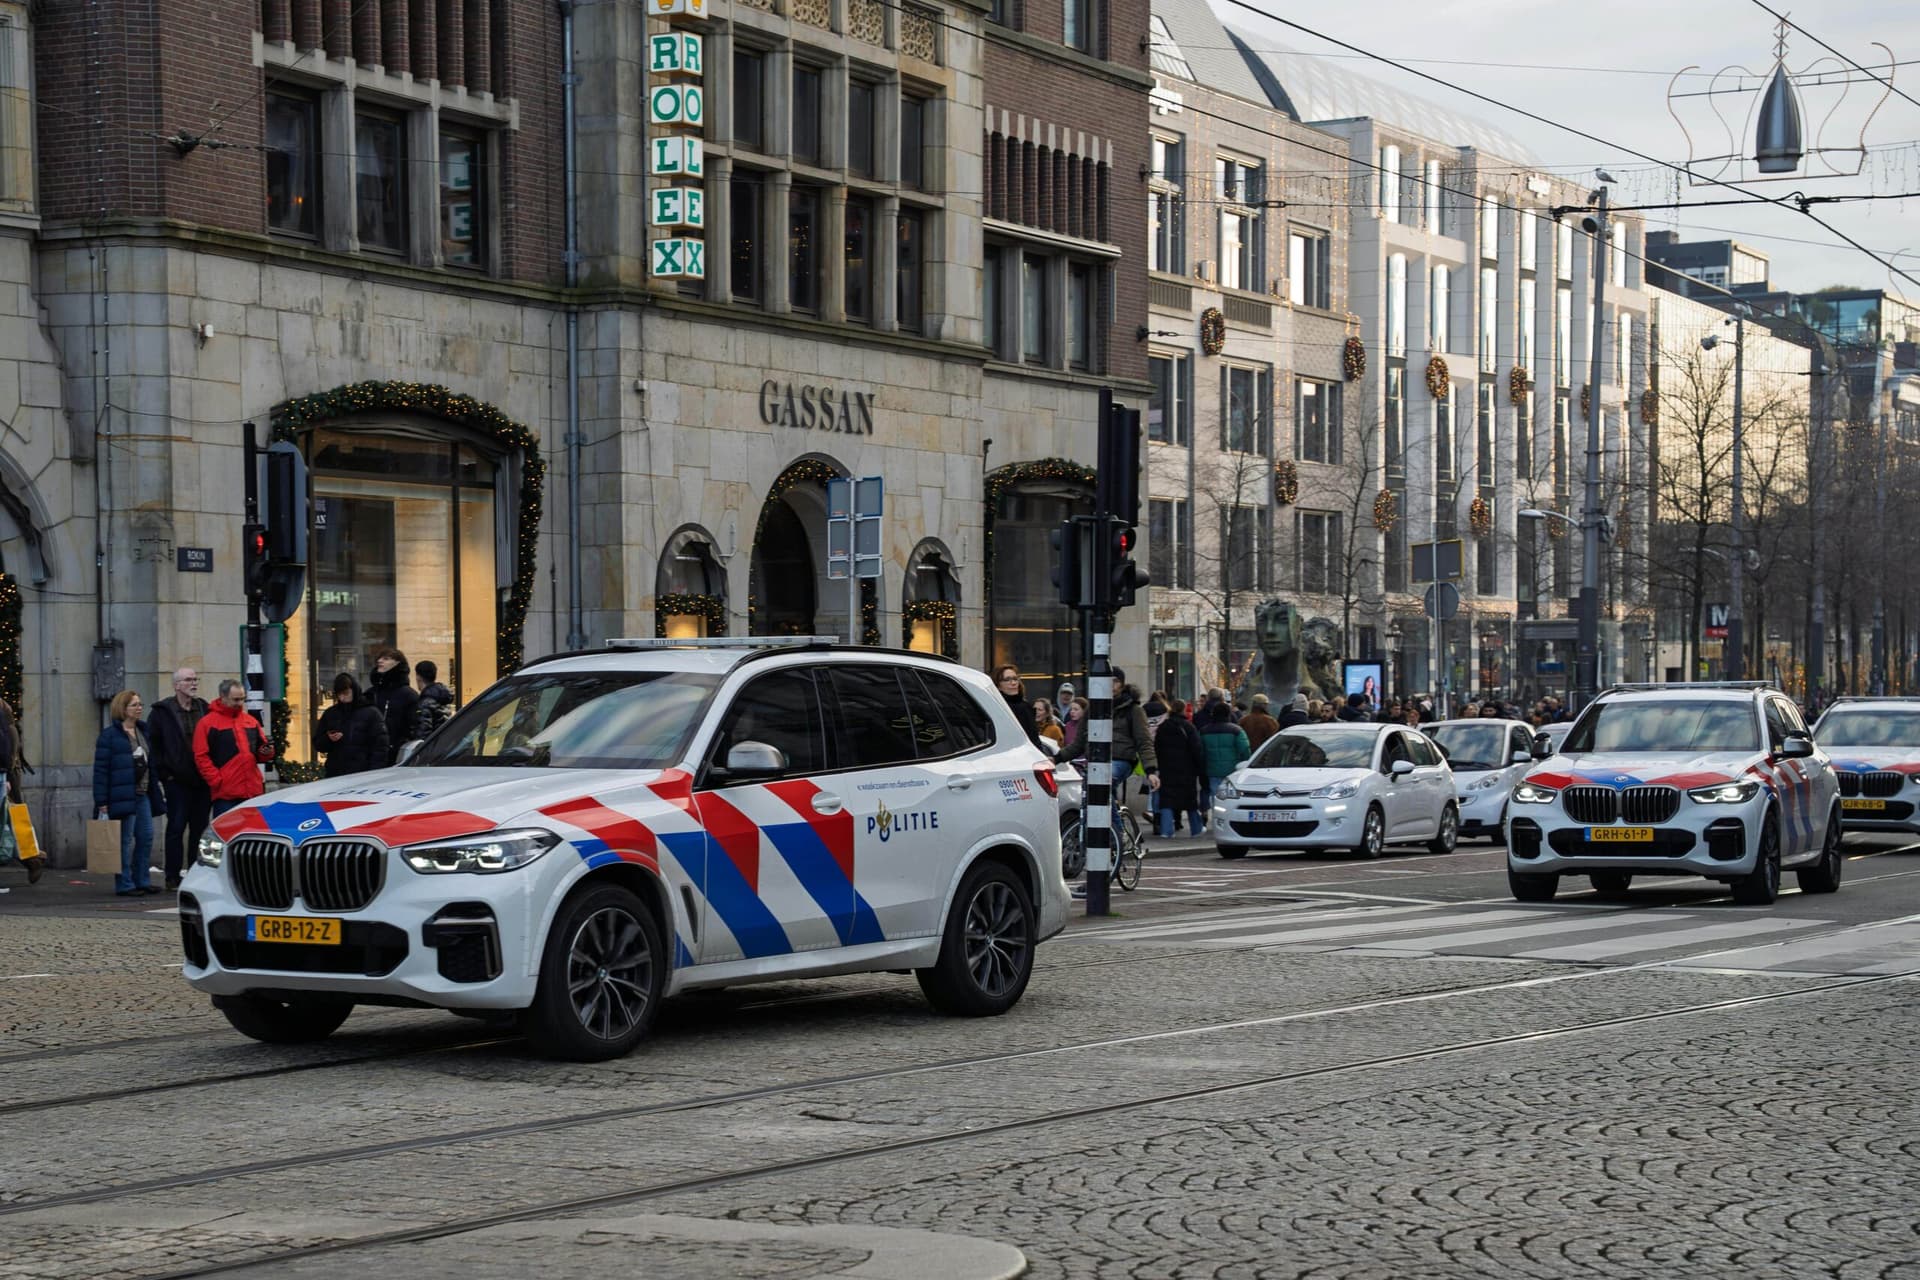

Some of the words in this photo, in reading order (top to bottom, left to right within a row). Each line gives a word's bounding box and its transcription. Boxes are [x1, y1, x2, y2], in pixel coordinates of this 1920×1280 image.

[652, 36, 682, 274] ROLEX
[684, 36, 703, 275] ROLEX
[759, 379, 876, 436] GASSAN
[1013, 778, 1029, 792] 112
[867, 811, 939, 842] POLITIE
[1594, 825, 1648, 840] GRH-61-P
[261, 919, 331, 940] GRB-12-Z
